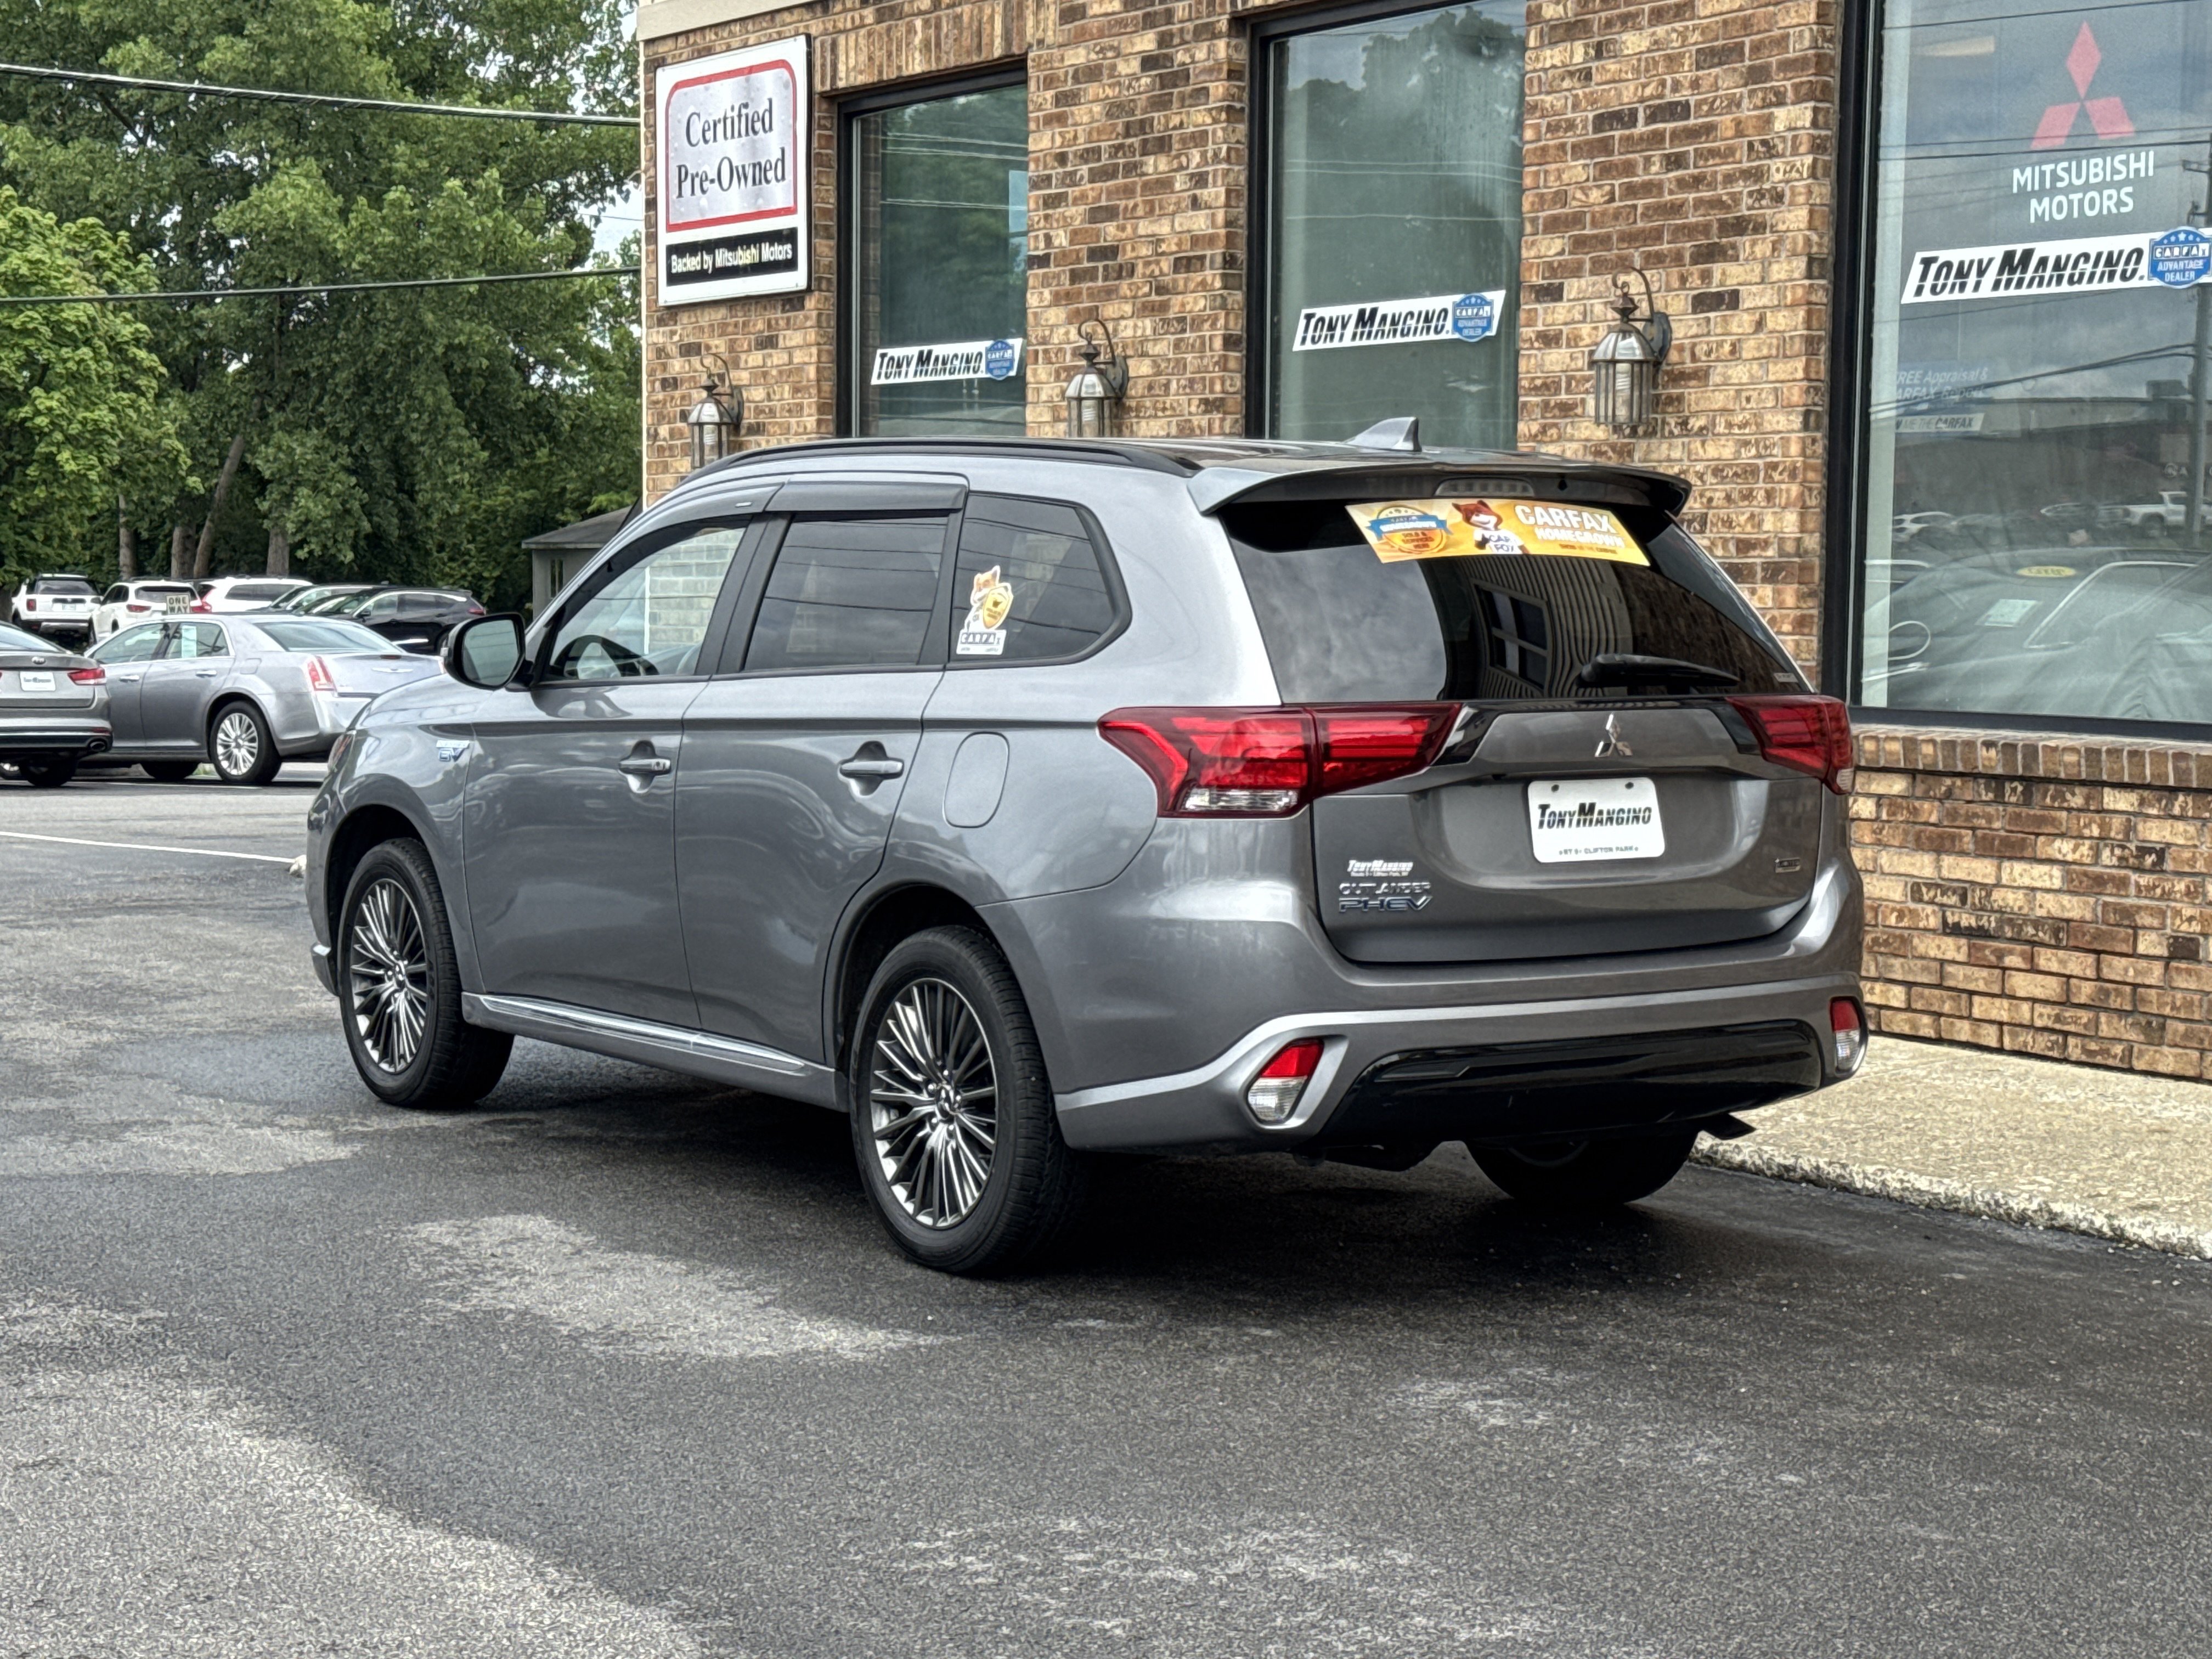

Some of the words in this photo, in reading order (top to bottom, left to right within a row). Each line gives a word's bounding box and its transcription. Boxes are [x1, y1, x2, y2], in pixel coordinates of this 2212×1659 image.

[685, 98, 774, 147] Certified
[676, 147, 786, 199] Pre-Owned
[2012, 151, 2154, 193] MITSUBISHI
[2030, 187, 2134, 223] MOTORS
[671, 251, 701, 273] Backed
[703, 251, 713, 274] by
[715, 243, 759, 268] Mitsubishi
[761, 242, 792, 262] Motors
[2155, 245, 2209, 258] CARFAX
[2157, 259, 2204, 271] ADVANTAGE
[2165, 271, 2195, 282] DEALER
[1514, 505, 1617, 534] CARFAX
[1534, 527, 1625, 548] HOMEGROWN
[168, 596, 187, 605] ONE
[168, 605, 188, 614] WAY
[1339, 895, 1433, 913] PHEV
